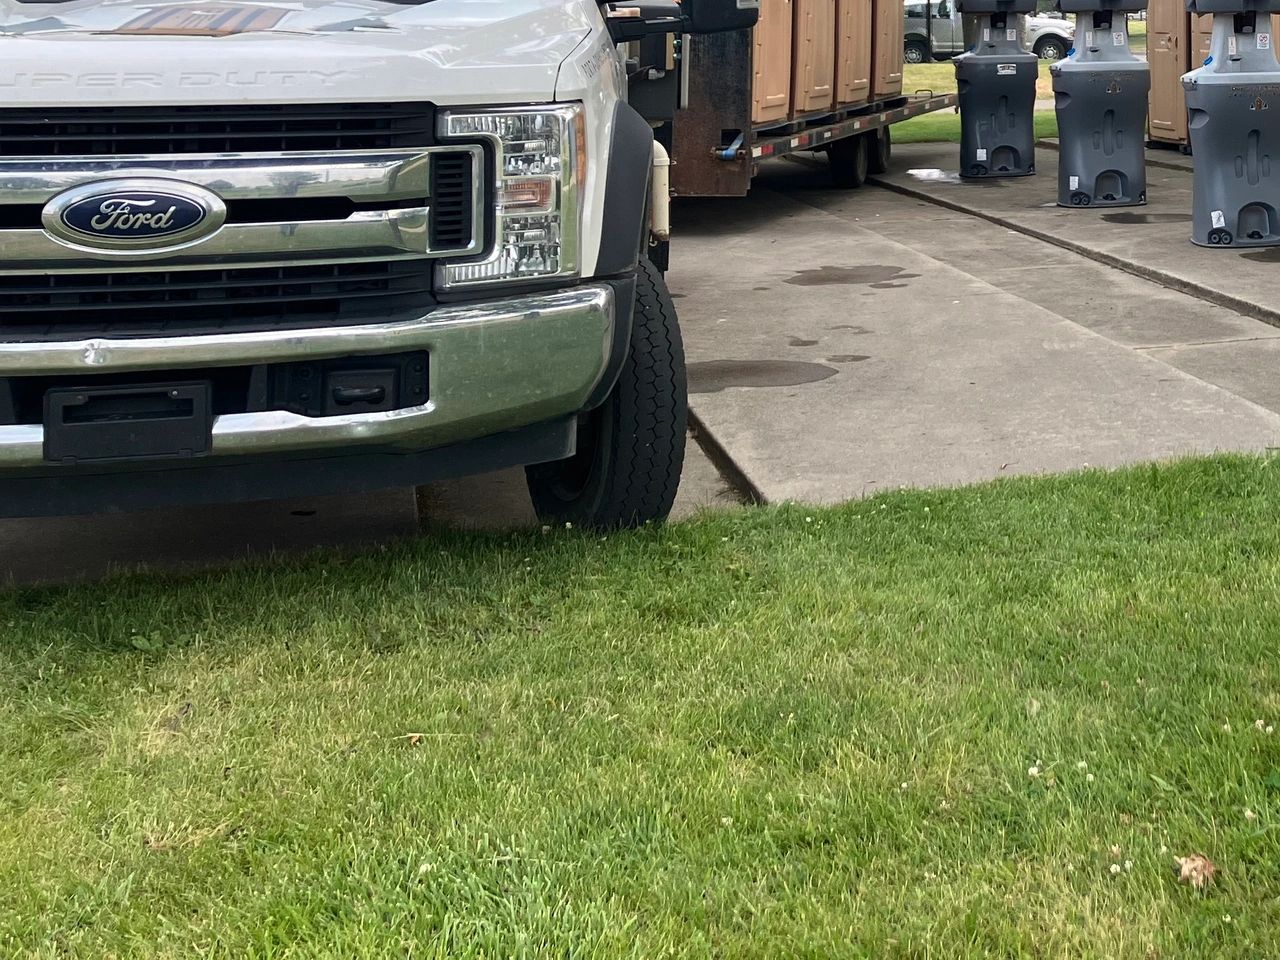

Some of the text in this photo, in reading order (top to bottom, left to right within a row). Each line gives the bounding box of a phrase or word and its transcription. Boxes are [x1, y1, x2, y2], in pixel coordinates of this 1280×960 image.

[0, 71, 347, 89] UPER DUTY
[90, 199, 176, 230] Ford
